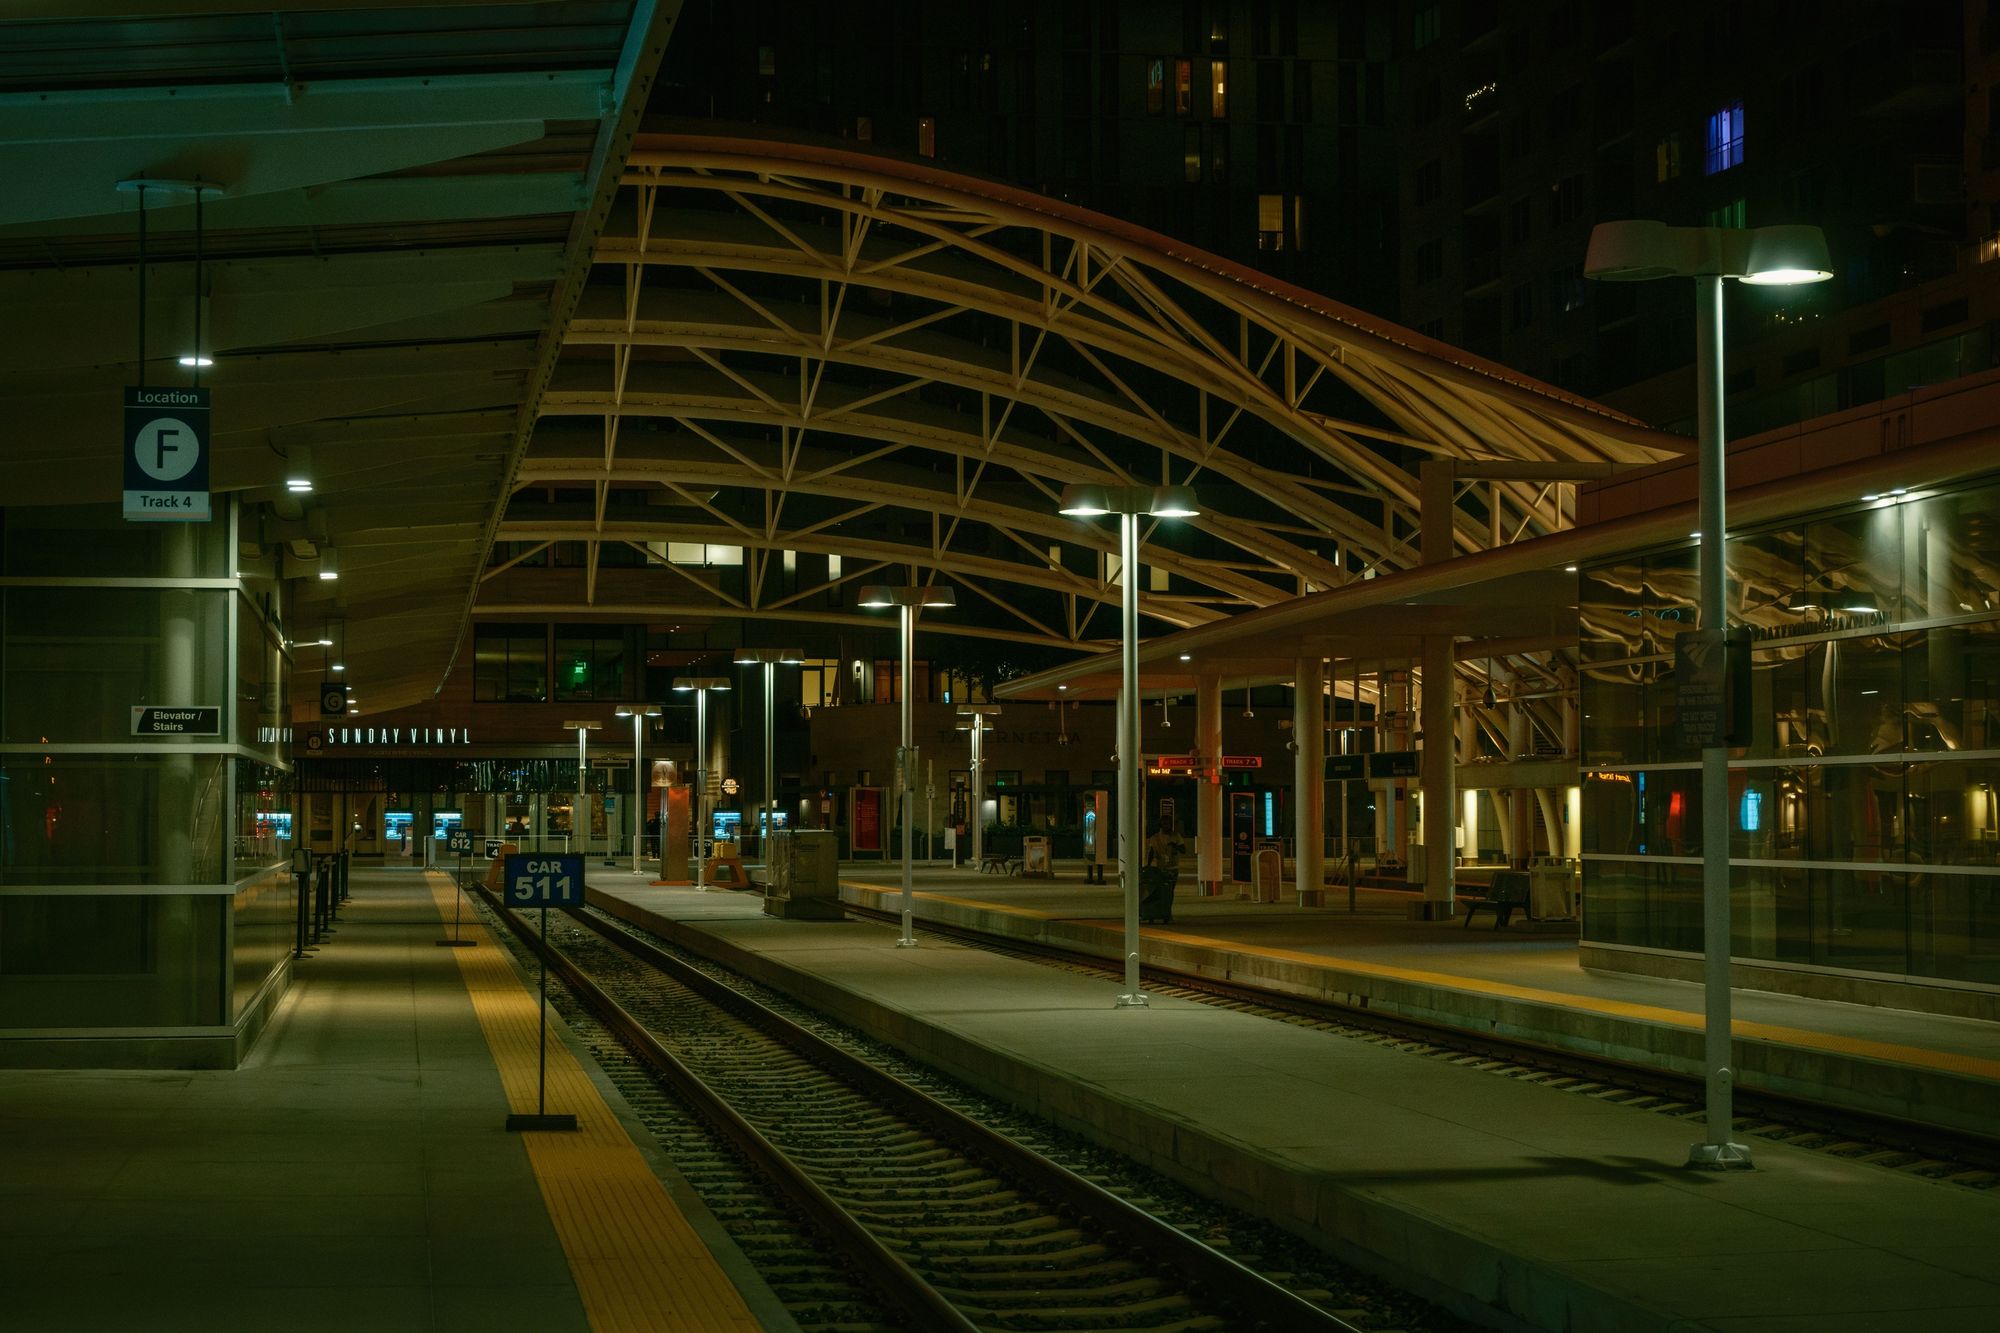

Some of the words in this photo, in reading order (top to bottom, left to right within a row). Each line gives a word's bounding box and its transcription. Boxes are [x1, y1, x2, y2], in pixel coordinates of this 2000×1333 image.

[137, 391, 198, 404] Location
[156, 429, 180, 469] F
[141, 495, 178, 508] Track
[183, 496, 192, 508] 4
[328, 695, 339, 708] G
[153, 711, 196, 720] Elevator
[153, 722, 184, 731] Stairs
[328, 728, 399, 744] SUNDAY
[411, 728, 470, 744] VINYL
[450, 839, 471, 850] 612
[491, 848, 499, 857] 4
[526, 861, 562, 874] CAR
[515, 876, 570, 900] 511
